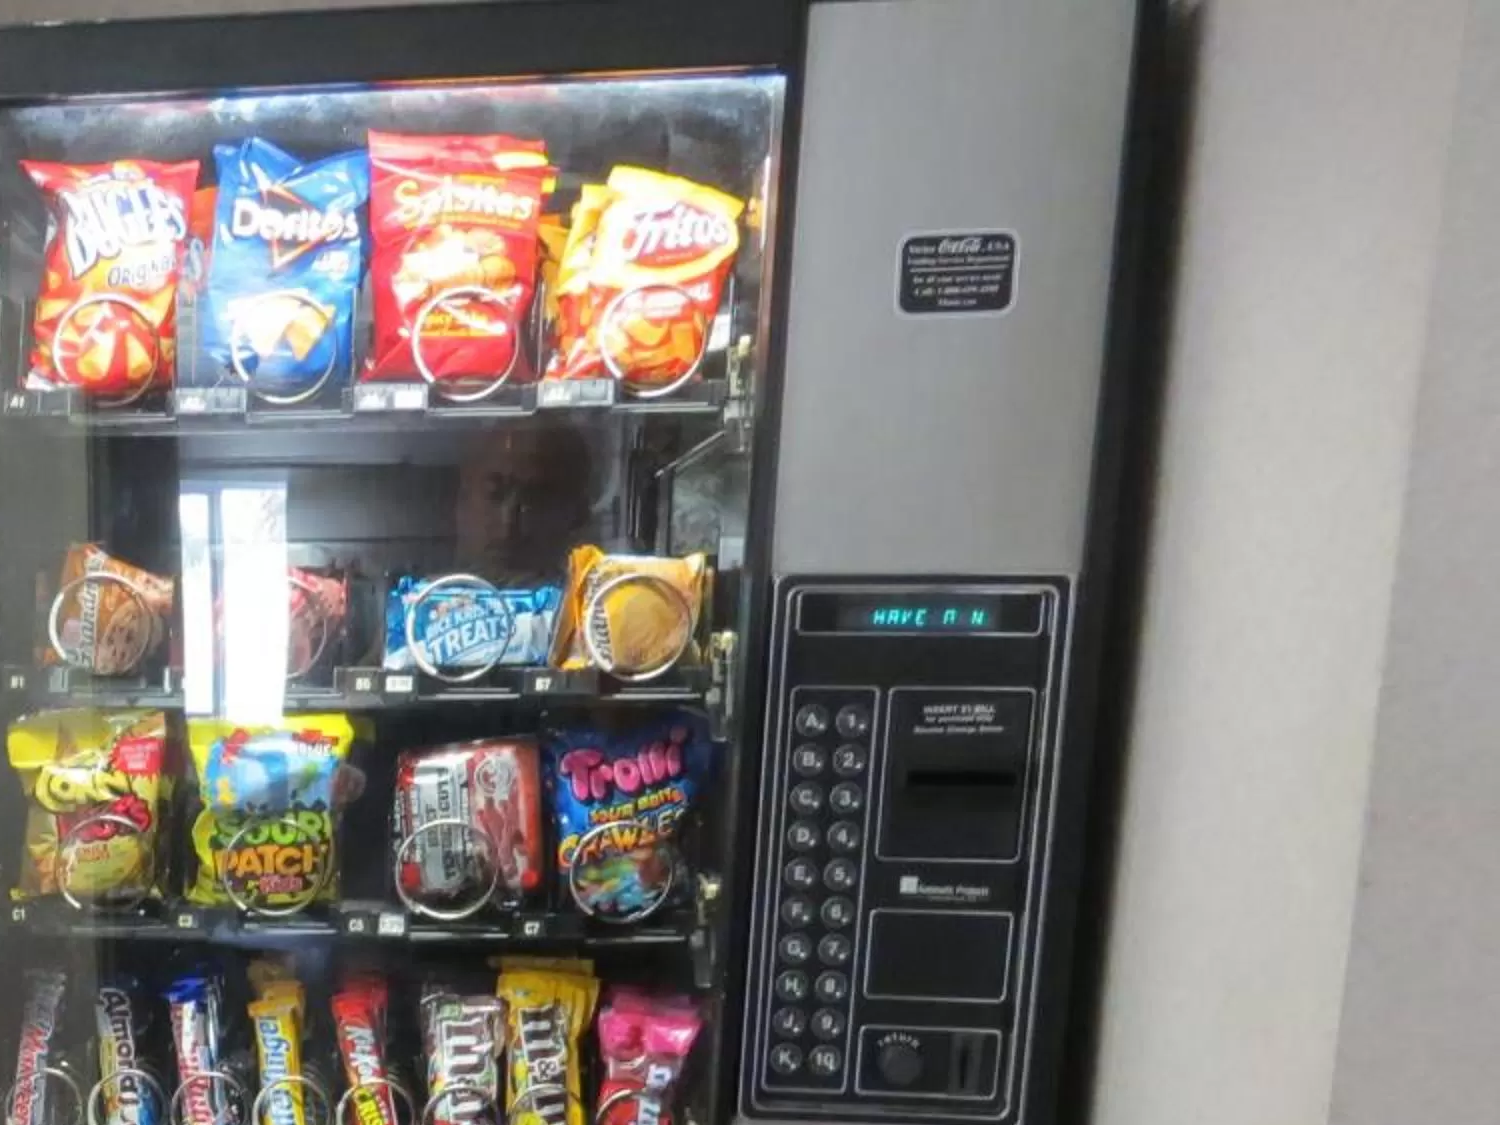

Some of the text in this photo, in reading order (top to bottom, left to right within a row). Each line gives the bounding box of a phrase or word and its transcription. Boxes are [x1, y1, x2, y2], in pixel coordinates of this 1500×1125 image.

[232, 197, 360, 241] Doritos
[624, 201, 730, 259] Fritos
[429, 616, 513, 665] TREATS
[871, 608, 986, 627] HAVE A N
[560, 727, 687, 801] Trolli
[214, 810, 326, 845] SOUR
[212, 843, 330, 878] PATCH
[100, 987, 137, 1093] Almond
